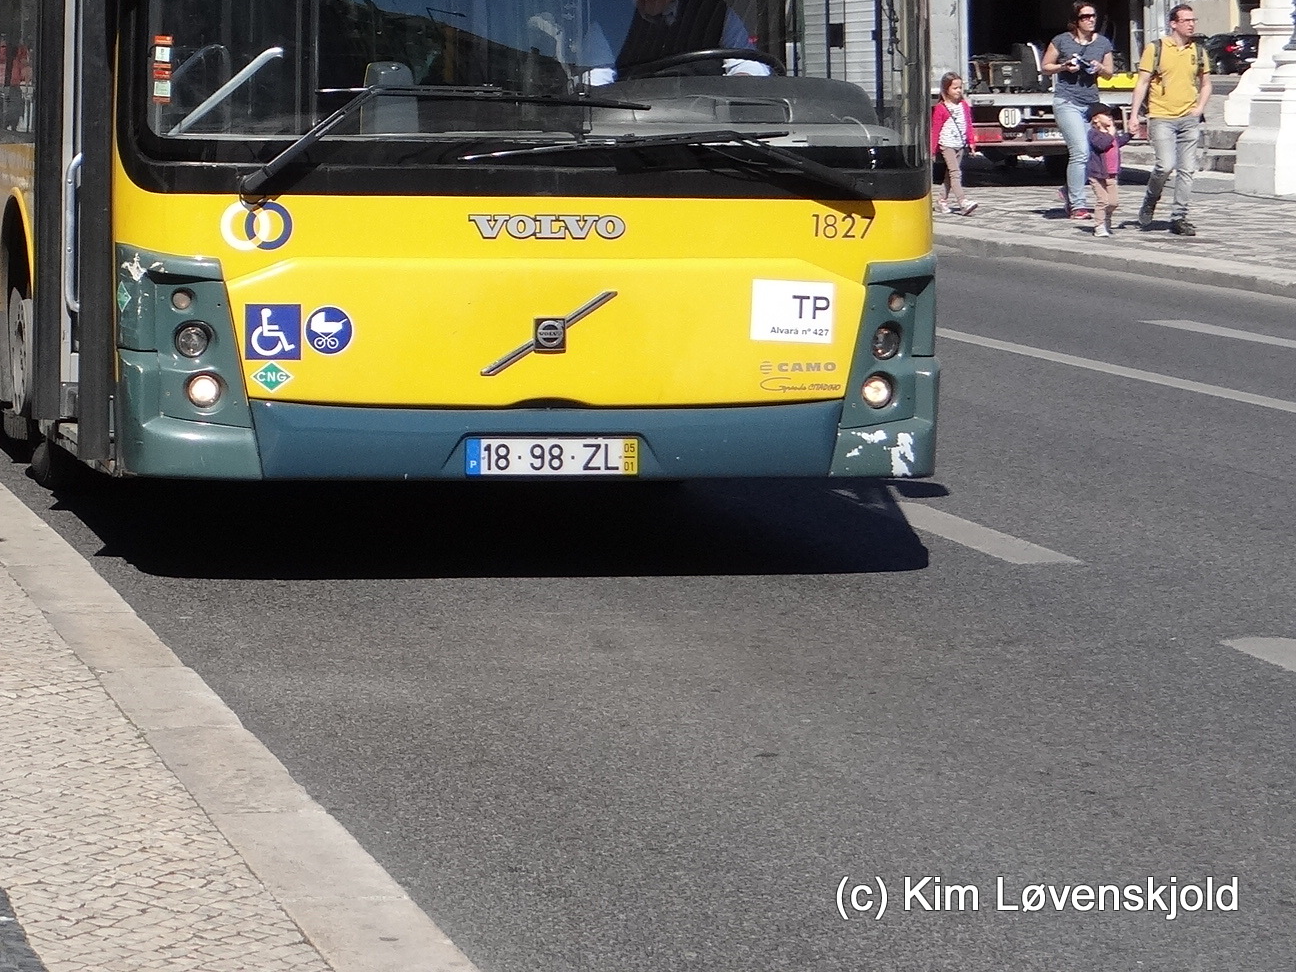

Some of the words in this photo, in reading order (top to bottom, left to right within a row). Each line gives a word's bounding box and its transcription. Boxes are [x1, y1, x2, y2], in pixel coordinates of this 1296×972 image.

[1003, 109, 1017, 126] 80
[468, 213, 626, 240] VOLVO
[811, 213, 874, 239] 1827
[792, 294, 831, 320] TP
[770, 326, 799, 335] Alvará
[812, 328, 829, 337] 427
[777, 361, 837, 373] CAMO
[256, 371, 288, 382] CNG
[623, 442, 636, 453] 05
[469, 460, 477, 469] P
[623, 461, 635, 472] 01
